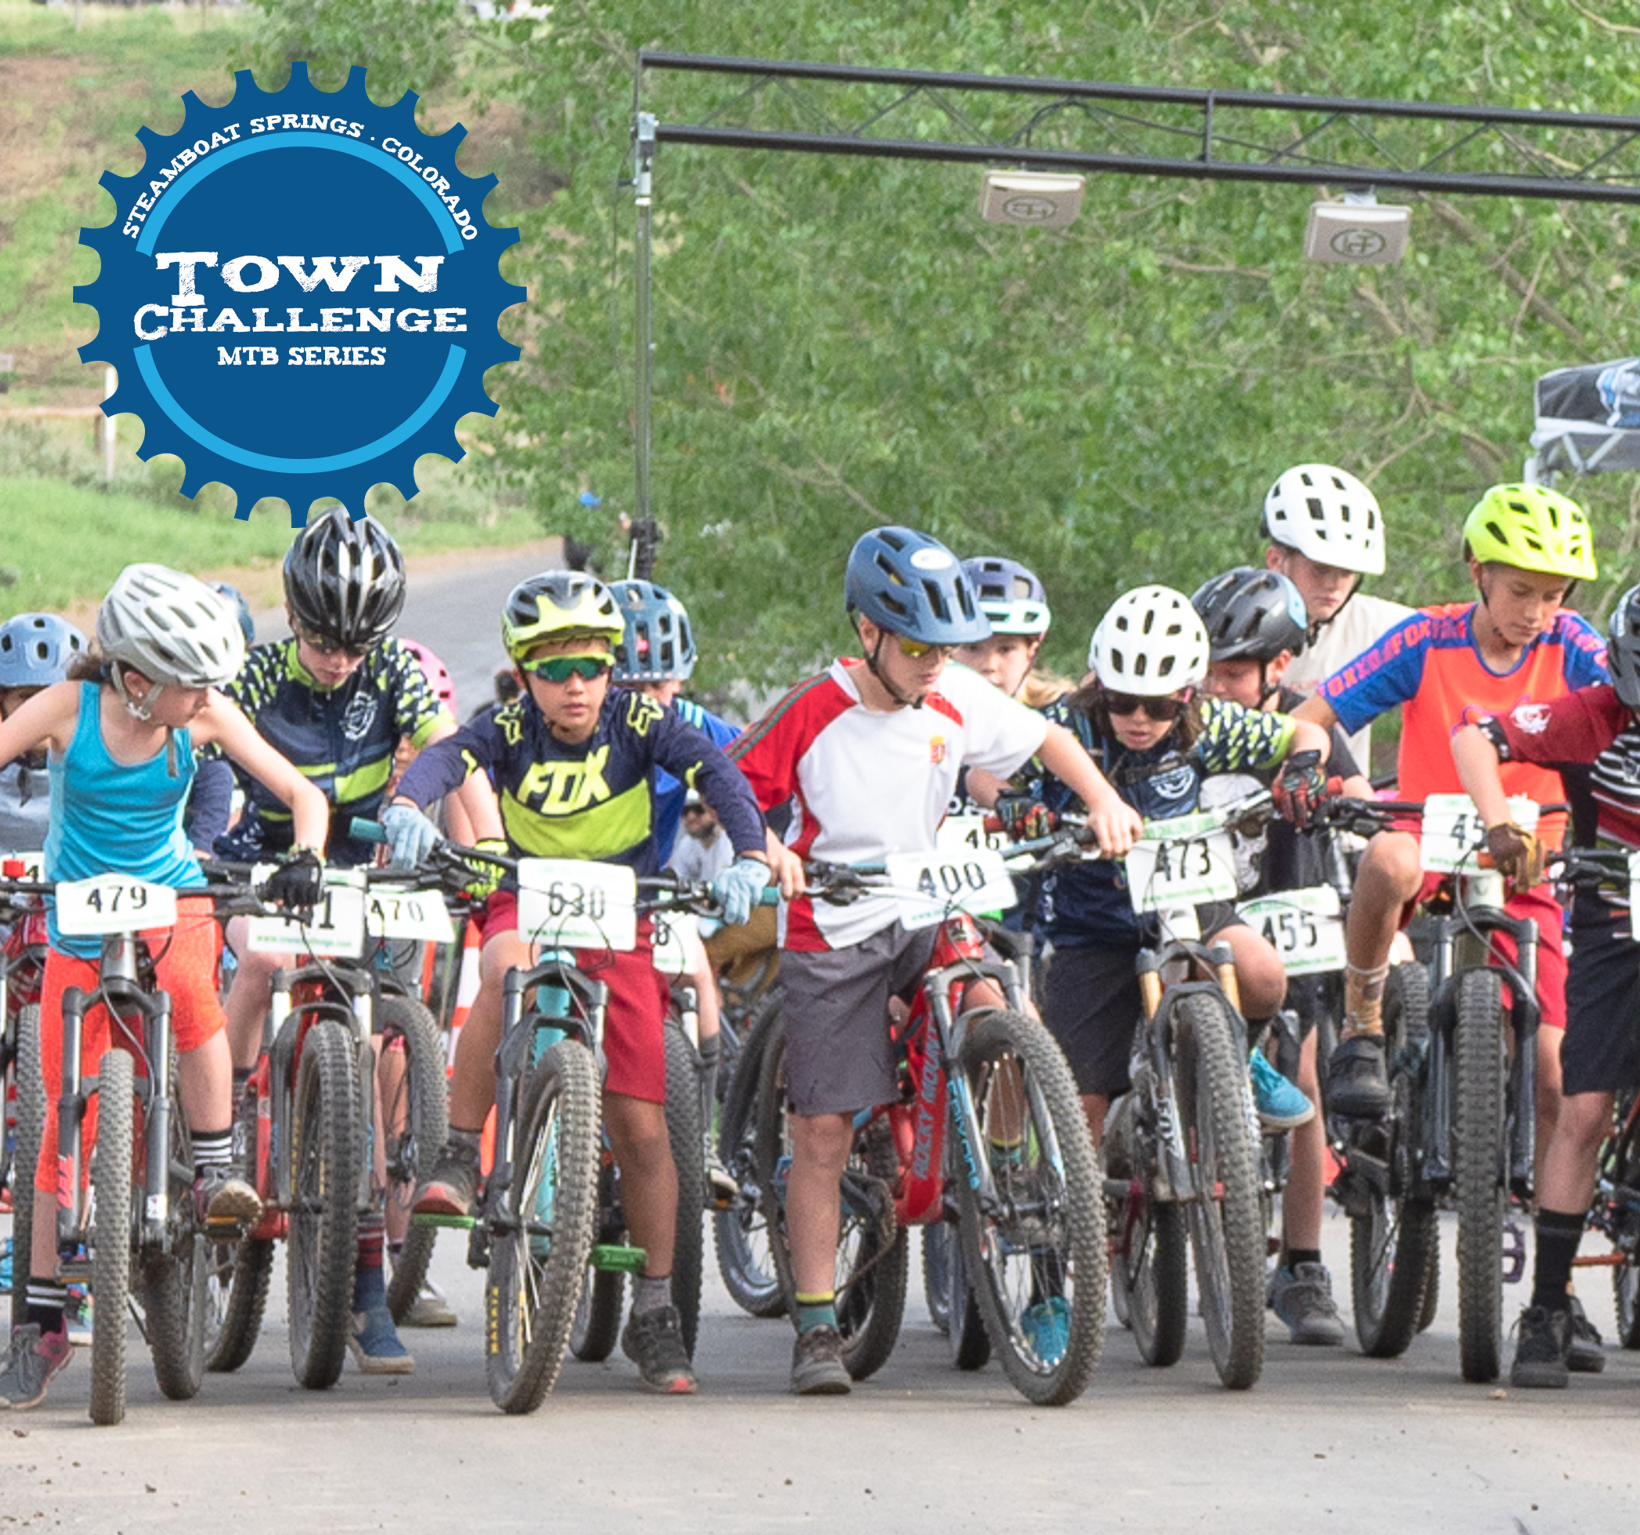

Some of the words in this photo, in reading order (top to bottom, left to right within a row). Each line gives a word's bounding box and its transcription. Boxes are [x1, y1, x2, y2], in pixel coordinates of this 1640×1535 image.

[516, 744, 611, 815] FOX
[1450, 814, 1488, 851] 45
[1156, 838, 1211, 881] 473
[86, 885, 147, 913] 479
[917, 862, 986, 898] 400
[371, 898, 424, 922] 470
[549, 881, 605, 920] 630
[1262, 910, 1317, 952] 455
[913, 1106, 933, 1180] ROCKY
